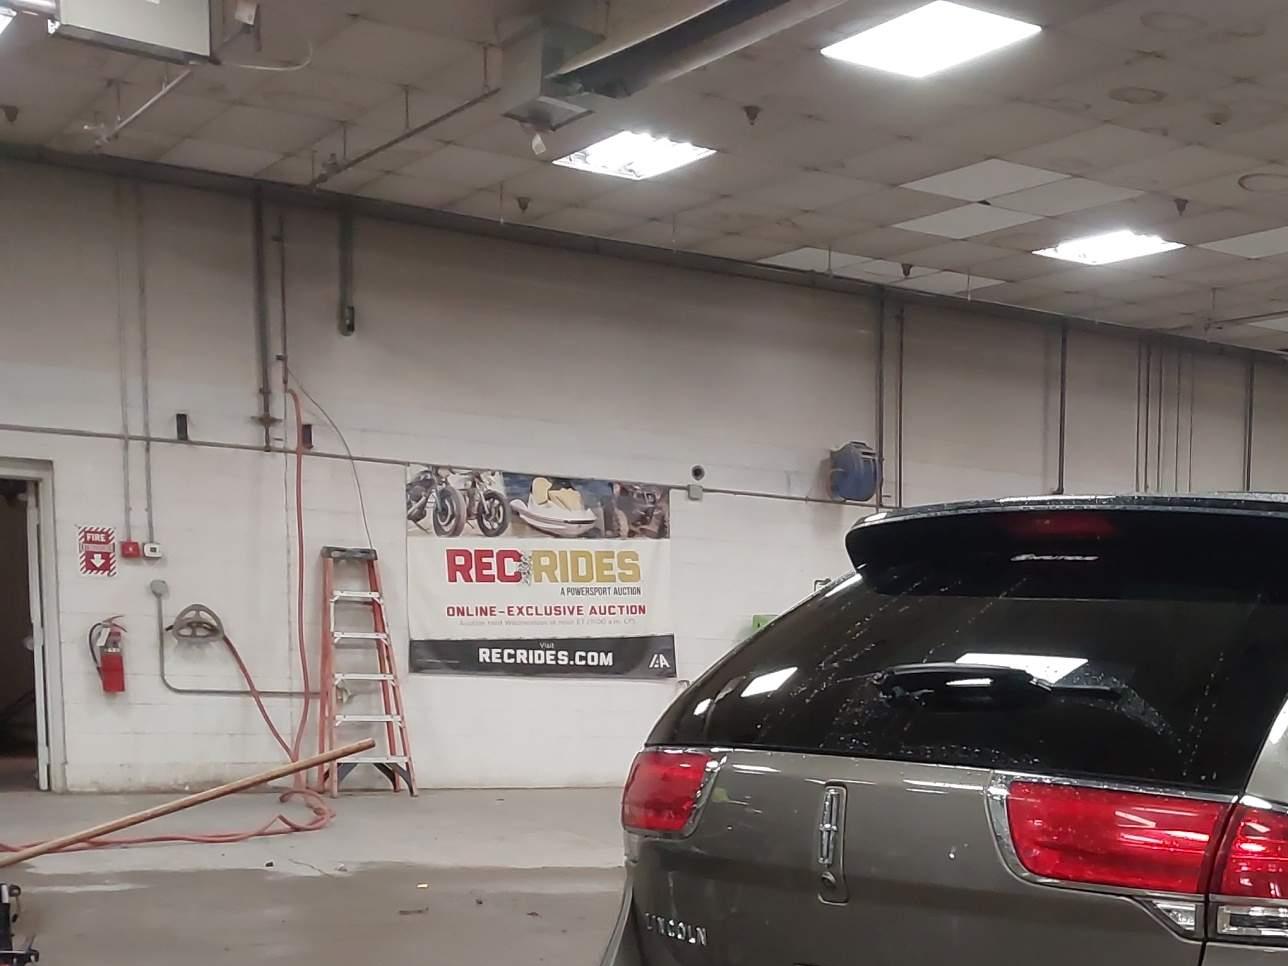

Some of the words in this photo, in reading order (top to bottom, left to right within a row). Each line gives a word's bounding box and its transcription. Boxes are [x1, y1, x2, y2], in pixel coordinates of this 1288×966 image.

[86, 533, 106, 542] FIRE
[531, 550, 641, 583] RIDES
[560, 587, 566, 596] A
[566, 586, 611, 596] POWERSPORT
[613, 586, 641, 596] AUCTION
[446, 605, 584, 617] ONLINE-EXCLUSIVE
[589, 604, 646, 616] AUCTION
[478, 647, 614, 666] RECRIDES.COM
